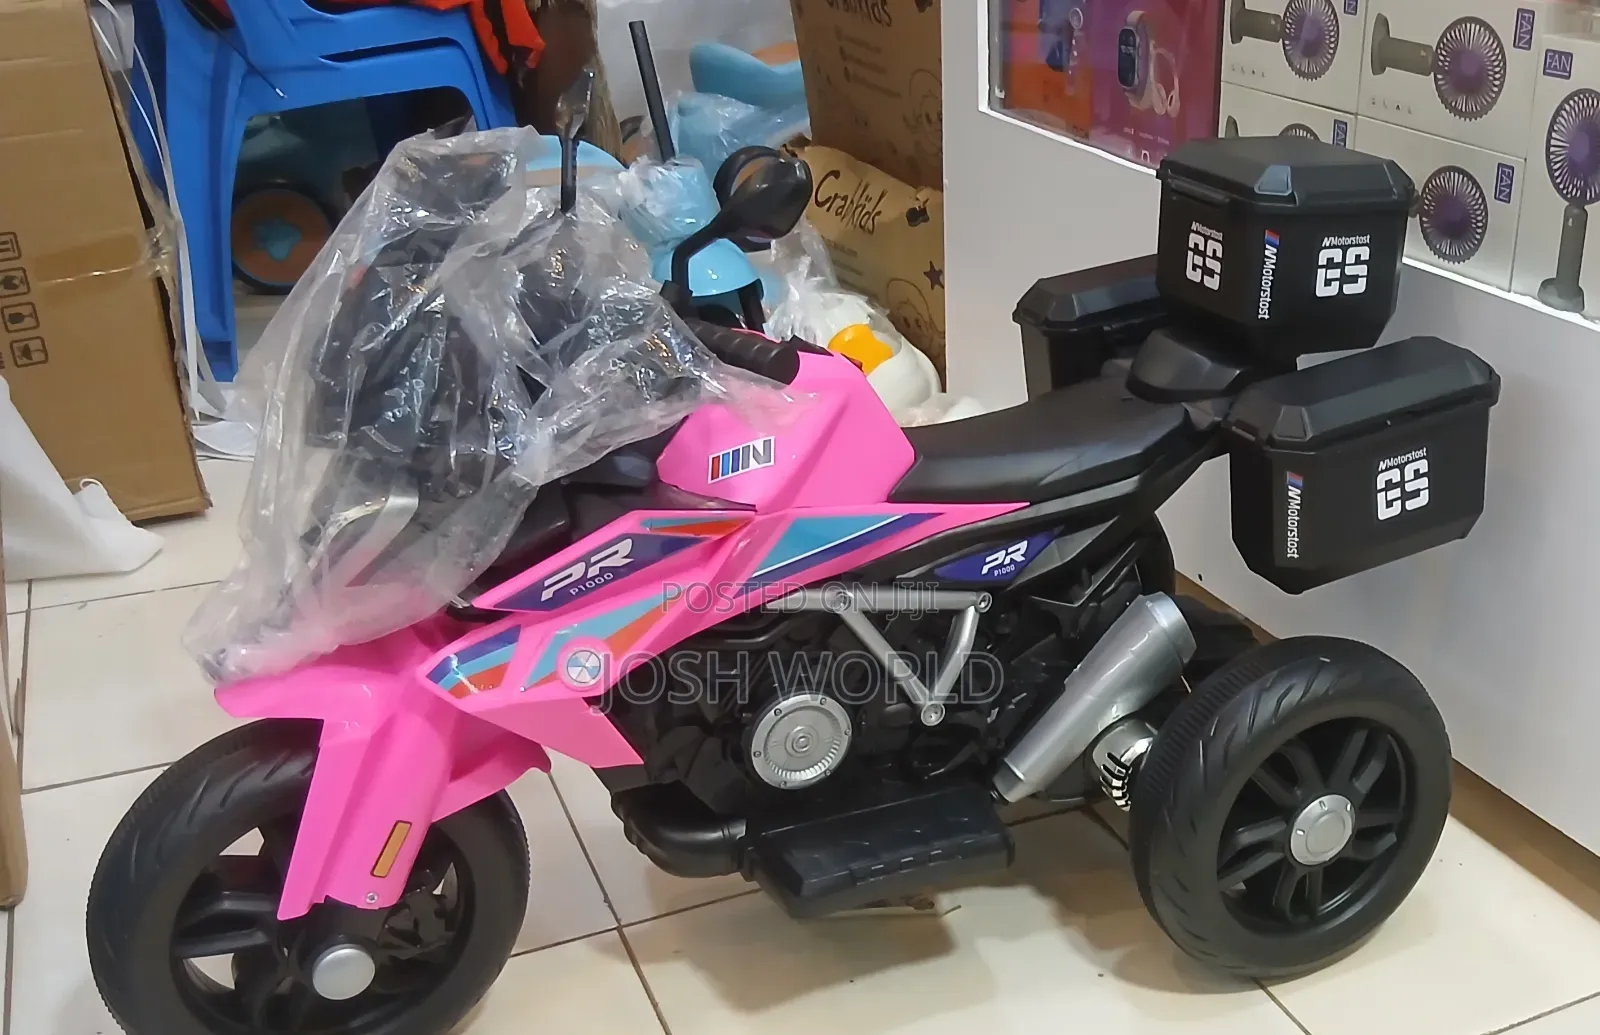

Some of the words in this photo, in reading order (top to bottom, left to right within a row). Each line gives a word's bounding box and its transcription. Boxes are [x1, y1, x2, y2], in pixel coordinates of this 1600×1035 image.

[1518, 13, 1533, 48] FAN
[1545, 52, 1572, 72] FAN
[1499, 167, 1513, 201] FAN
[540, 538, 635, 602] PR
[981, 540, 1028, 575] PR
[994, 564, 1015, 577] P1000
[569, 572, 614, 596] P1000
